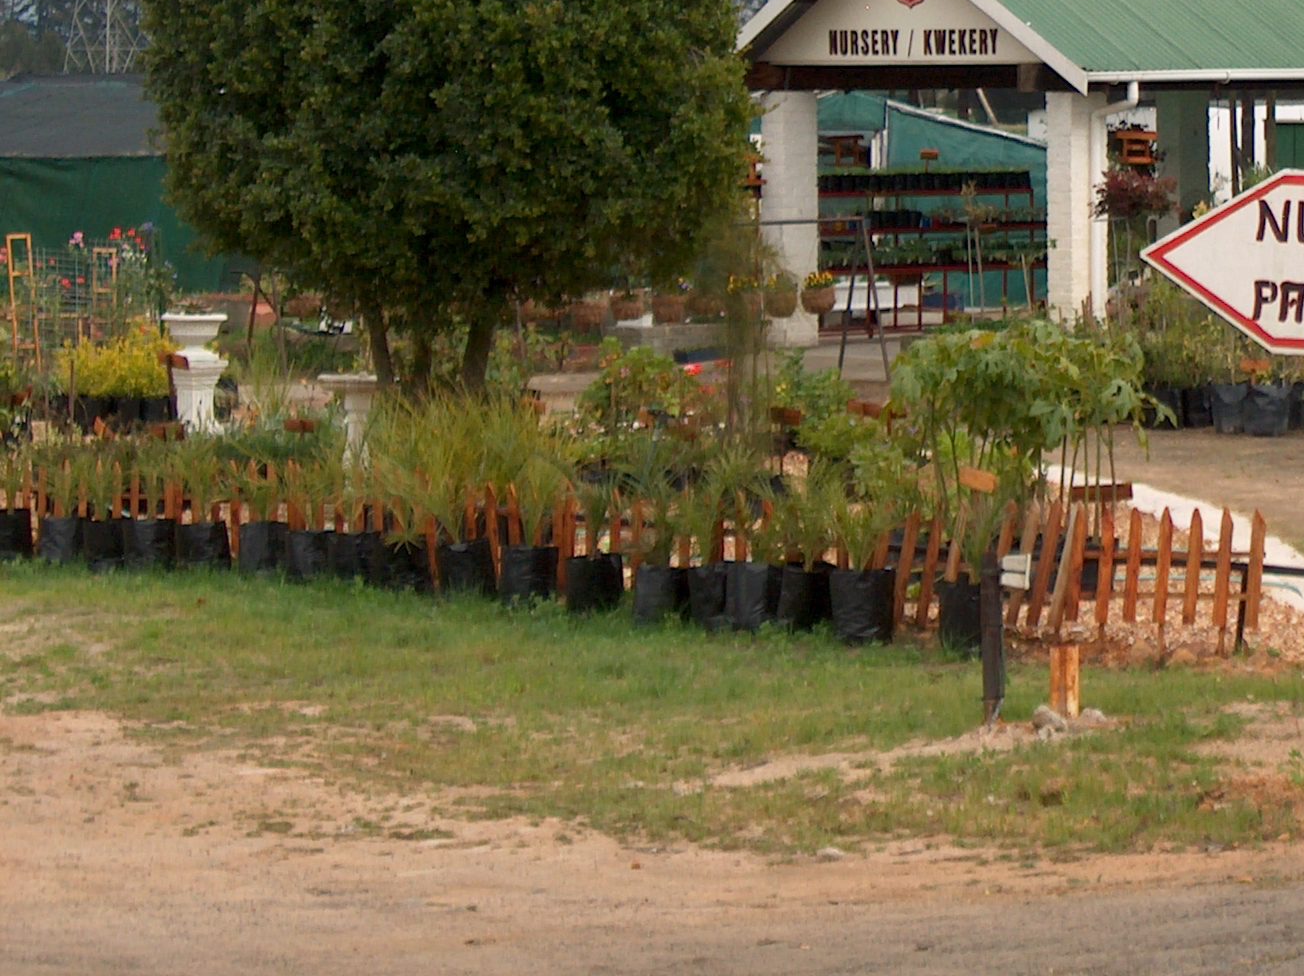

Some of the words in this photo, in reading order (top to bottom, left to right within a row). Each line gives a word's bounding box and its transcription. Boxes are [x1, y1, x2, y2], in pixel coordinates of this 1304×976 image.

[829, 29, 899, 56] NURSERY
[907, 29, 914, 57] /
[924, 28, 999, 55] KWEKERY
